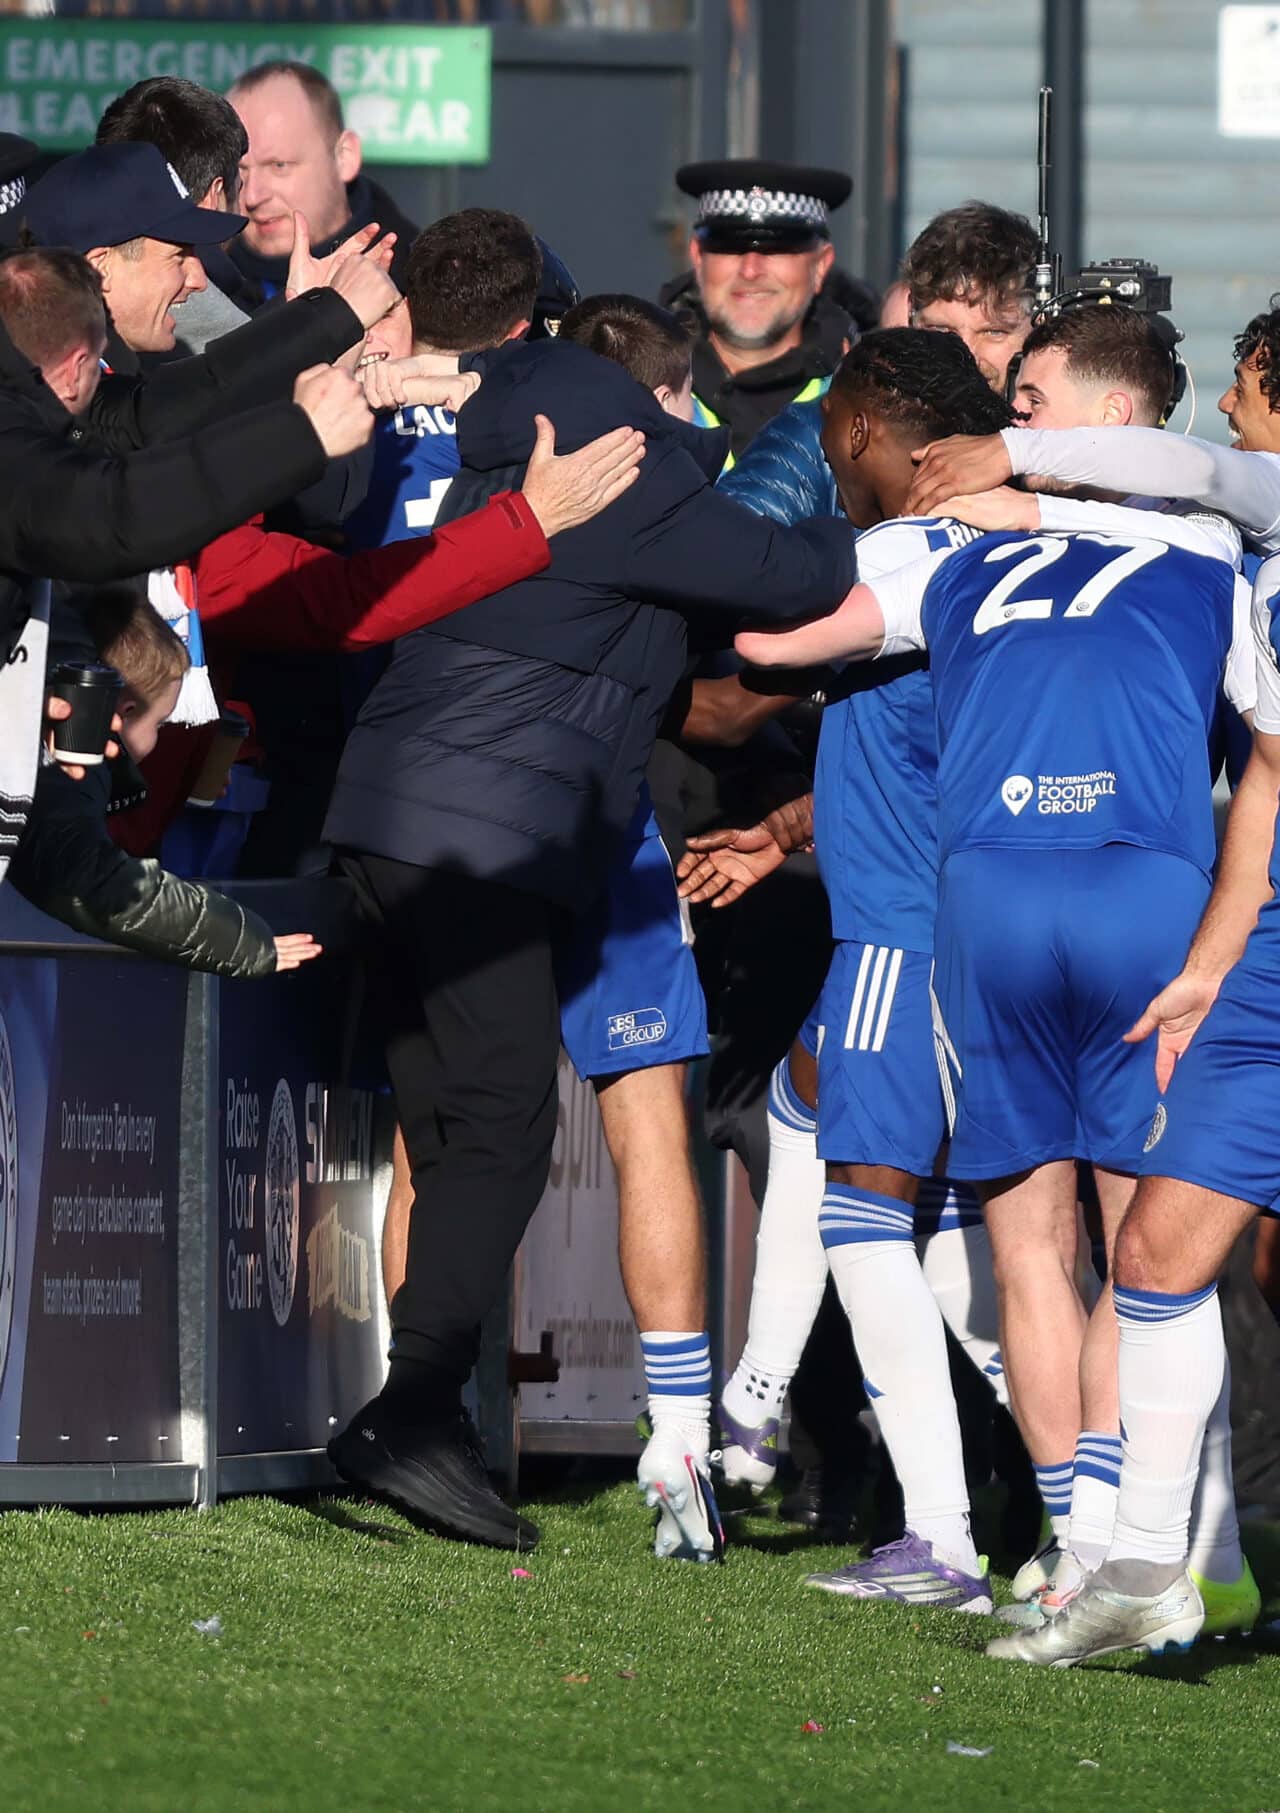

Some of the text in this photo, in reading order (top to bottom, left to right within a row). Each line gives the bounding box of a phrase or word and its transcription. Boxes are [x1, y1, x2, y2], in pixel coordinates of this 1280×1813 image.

[330, 44, 442, 87] EXIT
[973, 534, 1169, 635] 27
[1038, 770, 1117, 785] THE INTERNATIONAL
[1038, 780, 1116, 800] FOOTBALL
[1038, 799, 1097, 814] GROUP
[623, 1025, 663, 1044] GROUP
[114, 1102, 127, 1163] Tap
[226, 1078, 260, 1148] Raise
[226, 1158, 256, 1229] Your
[227, 1239, 262, 1309] Game
